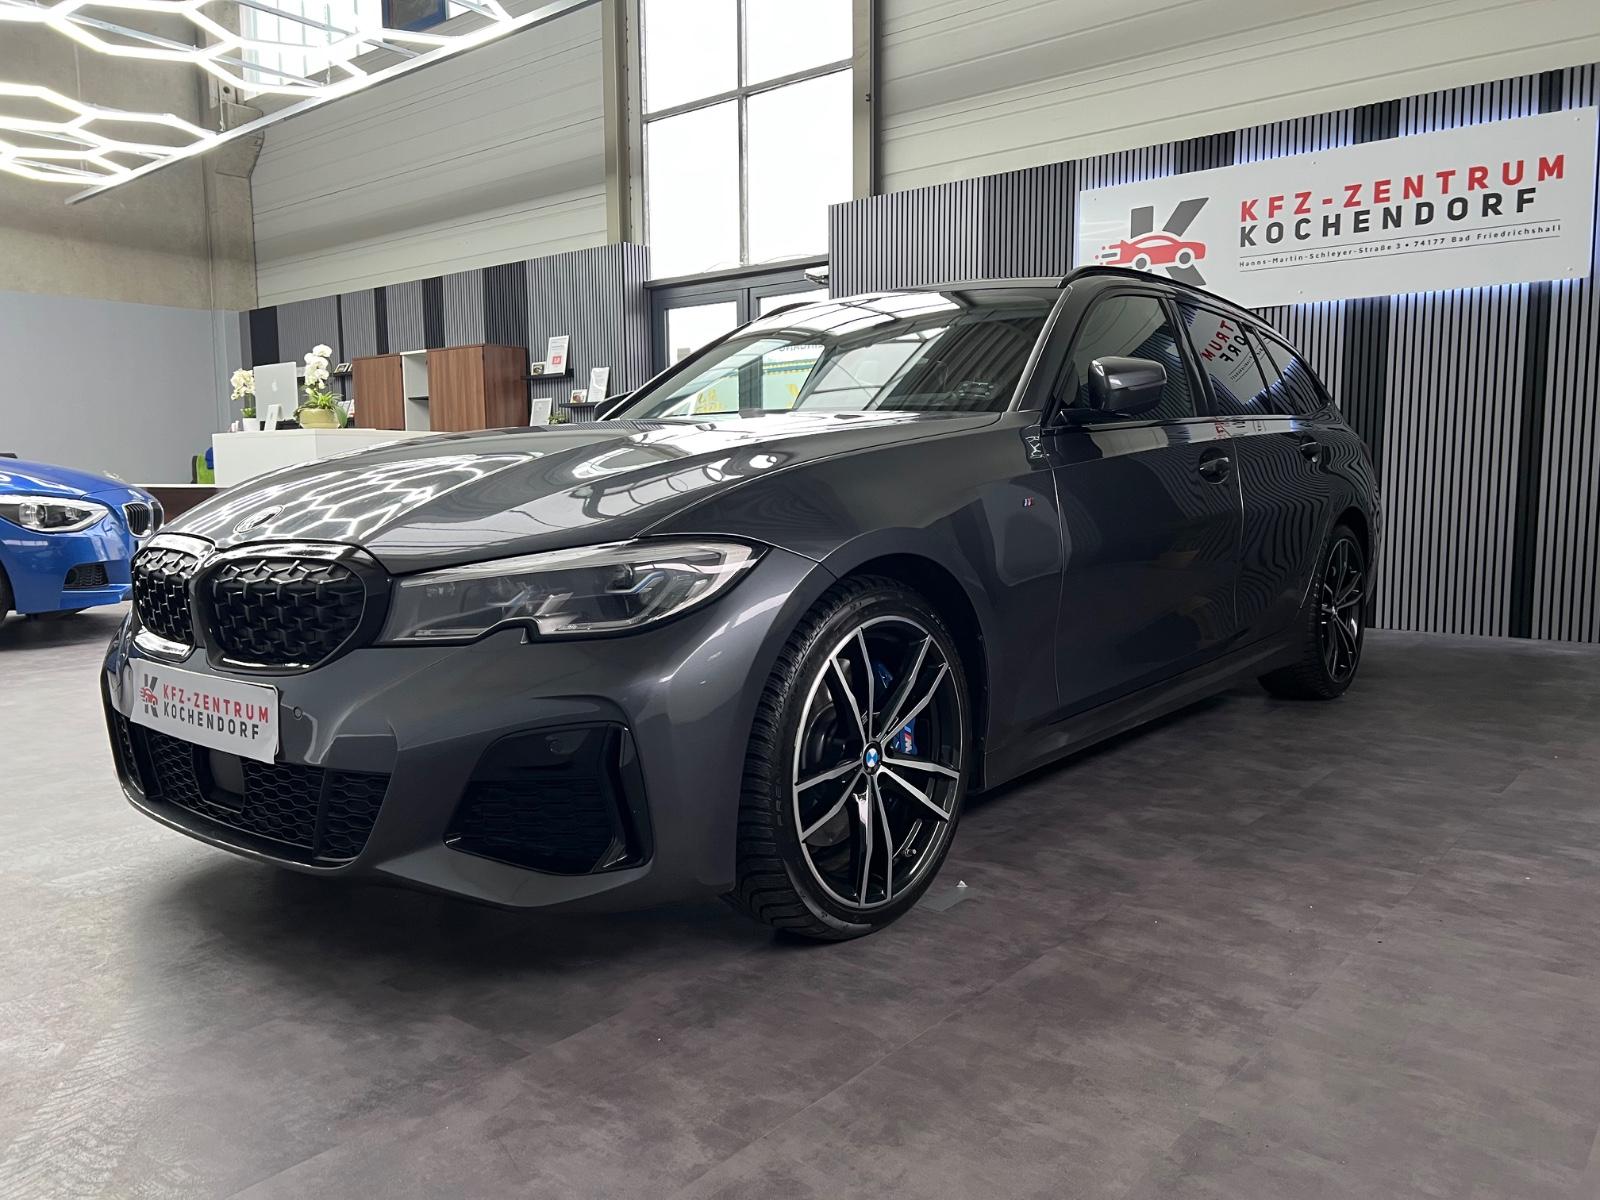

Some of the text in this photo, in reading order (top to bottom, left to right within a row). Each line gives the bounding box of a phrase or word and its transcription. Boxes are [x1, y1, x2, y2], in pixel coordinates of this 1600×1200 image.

[1240, 155, 1565, 222] KFZ-ZENTRUM
[1239, 187, 1537, 248] KOCHENDORF
[1413, 237, 1447, 248] 74177
[1451, 234, 1471, 243] Bad
[1476, 224, 1562, 240] Friedrichshall
[163, 684, 269, 723] KFZ-ZENTRUM
[163, 702, 259, 740] KOCHENDORF
